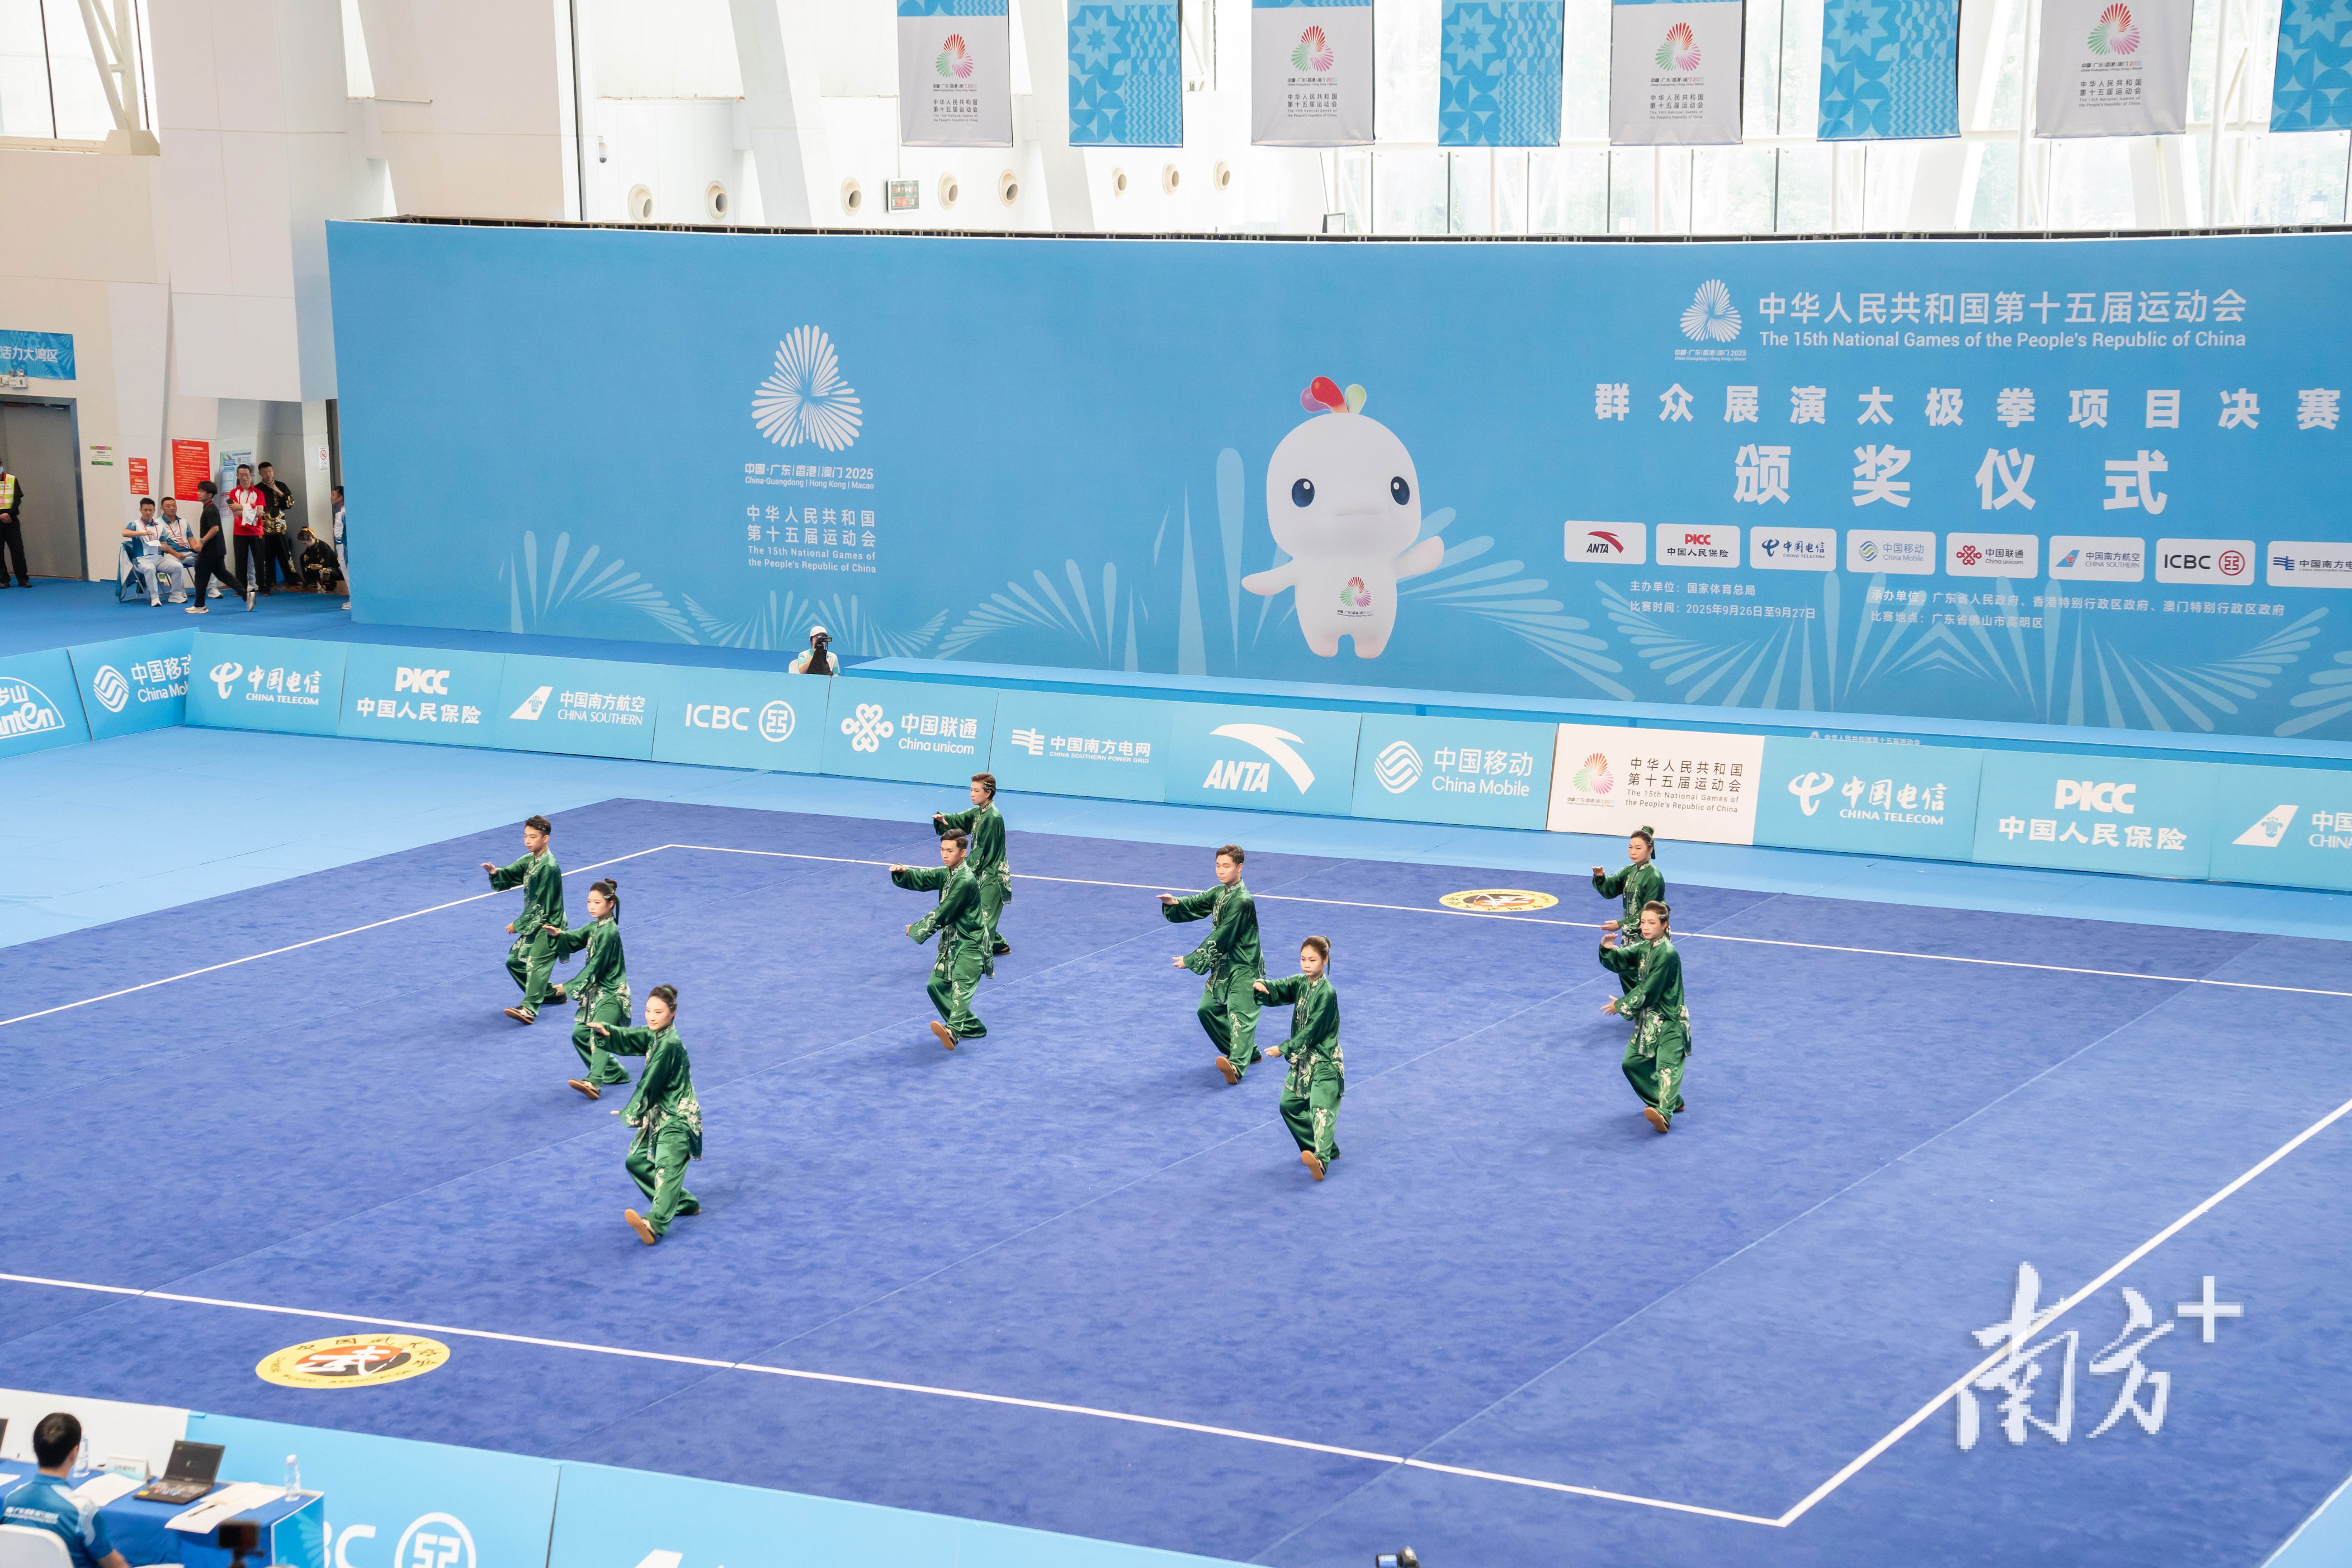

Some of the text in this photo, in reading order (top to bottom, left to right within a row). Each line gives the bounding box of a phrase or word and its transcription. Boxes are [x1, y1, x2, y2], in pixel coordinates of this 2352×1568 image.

[2080, 87, 2142, 96] 第十五届运动会
[2081, 79, 2142, 87] 中华人民共和国
[1759, 289, 2246, 324] 中华人民共和国第十五届运动会
[1759, 330, 2245, 351] The 15th National Games of the People's Republic of China
[0, 346, 58, 362] 活力大湾区
[1595, 383, 2340, 429] 群众展演太极拳项目决赛
[845, 467, 873, 480] 2025
[1733, 443, 2168, 514] 颁奖仪式
[810, 479, 827, 489] Hong
[829, 480, 846, 489] Kong
[852, 481, 874, 489] Macao
[747, 504, 875, 527] 中华人民共和国
[747, 524, 875, 547] 第十五届运动会
[1685, 534, 1711, 545] PICC
[748, 546, 875, 560] The 15th National Games of
[1586, 544, 1608, 554] ANTA
[1667, 547, 1728, 558] 中国人民保险
[1783, 540, 1825, 553] 中国电信
[1883, 543, 1924, 554] 中国移动
[1986, 549, 2023, 558] 中国联通
[2086, 551, 2140, 561] 中国南方航空
[2165, 554, 2211, 569] ICBC
[749, 558, 876, 573] the People's Republic of China
[1630, 580, 1755, 596] 主办单位：国家体育总局
[248, 665, 322, 694] 中国电信
[395, 667, 450, 695] PICC
[138, 687, 169, 702] China
[246, 693, 319, 705] CHINA TELECOM
[560, 690, 645, 712] 中国南方航空
[357, 697, 481, 724] 中国人民保险
[558, 709, 643, 725] CHINA SOUTHERN
[685, 703, 750, 731] ICBC
[901, 714, 977, 739] 中国联通
[899, 737, 974, 754] China unicom
[1051, 736, 1151, 757] 中国南方电网
[1434, 747, 1533, 777] 中国移动
[1631, 757, 1742, 777] 中华人民共和国
[1202, 759, 1270, 792] ANTA
[1628, 773, 1741, 792] 第十五届运动会
[1432, 776, 1529, 796] China Mobile
[1841, 776, 1947, 811] 中国电信
[1640, 800, 1670, 808] People's
[1673, 802, 1704, 810] Republic
[2055, 780, 2136, 814] PICC
[1839, 809, 1944, 825] CHINA TELECOM
[1999, 816, 2187, 850] 中国人民保险
